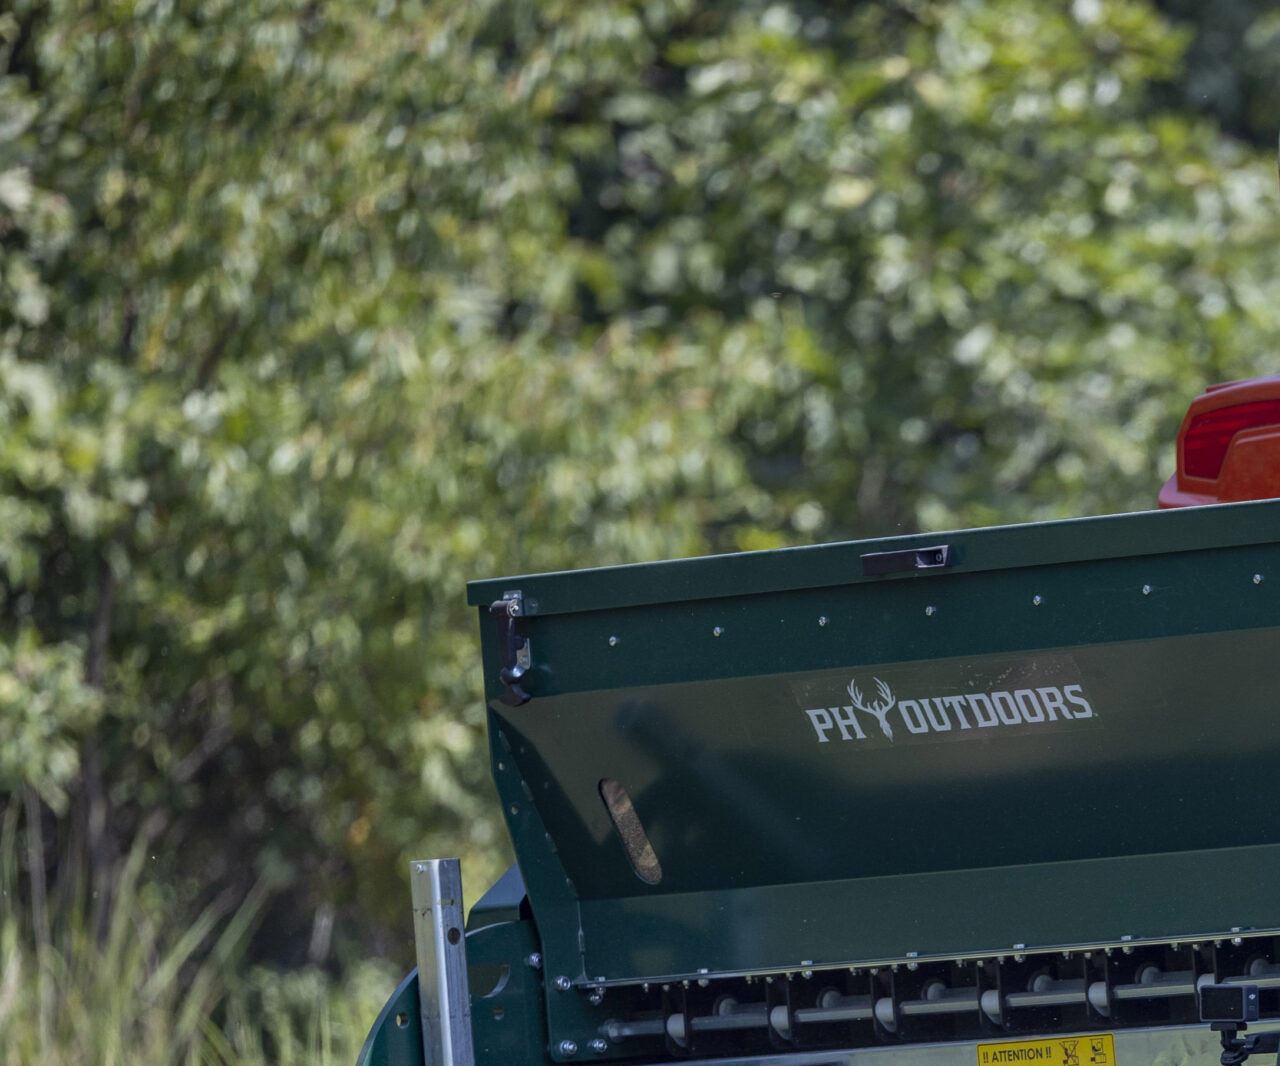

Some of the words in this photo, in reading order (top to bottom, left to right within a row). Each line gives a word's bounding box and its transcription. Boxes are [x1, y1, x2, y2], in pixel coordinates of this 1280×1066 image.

[805, 706, 867, 743] PH
[899, 684, 1093, 734] OUTDOORS
[992, 1047, 1043, 1063] ATTENTION
